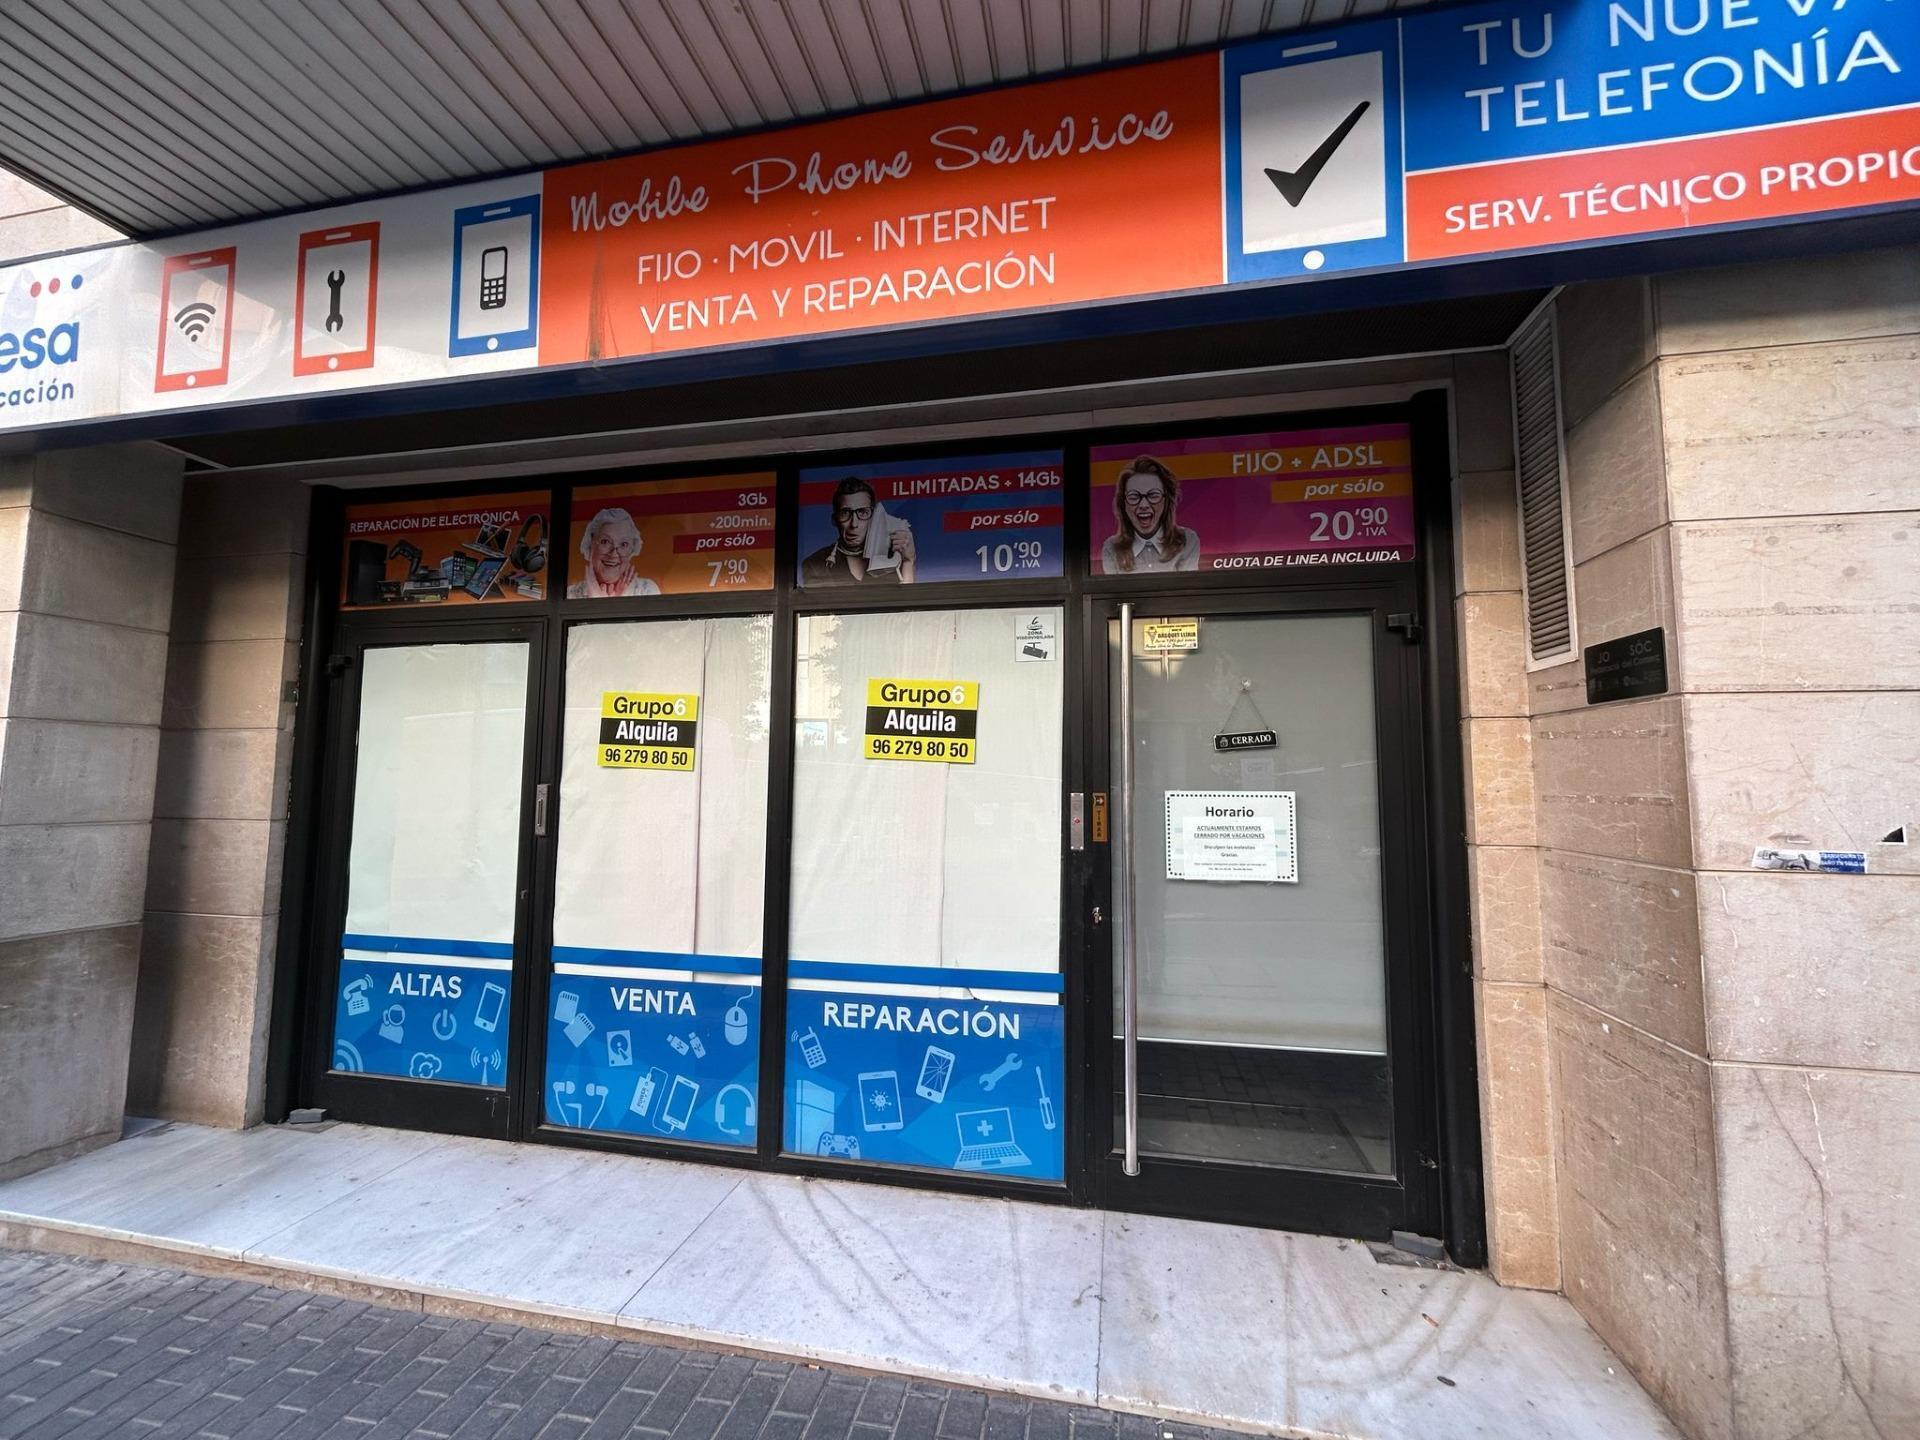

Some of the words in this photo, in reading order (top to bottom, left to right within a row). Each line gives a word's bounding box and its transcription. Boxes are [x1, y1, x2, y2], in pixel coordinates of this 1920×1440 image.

[1462, 13, 1553, 66] TU
[1609, 0, 1895, 47] NUE
[1465, 26, 1902, 132] TELEFONÍA
[732, 152, 912, 203] Phone
[930, 110, 1174, 171] Service
[1444, 196, 1551, 234] SERV.
[1560, 172, 1746, 218] TÉCNICO
[637, 250, 701, 285] FIJO
[729, 229, 844, 273] MOVIL
[873, 196, 1056, 251] INTERNET
[640, 293, 758, 334] VENTA
[771, 287, 792, 318] Y
[803, 250, 1055, 315] REPARACIÓN
[1232, 452, 1282, 474] FIJO
[1311, 445, 1383, 469] ADSL
[892, 474, 999, 496] ILIMITADAS
[1017, 471, 1060, 488] 14Gb
[1304, 483, 1338, 499] por
[1342, 478, 1384, 494] sólo
[737, 493, 768, 506] 3Gb
[421, 516, 437, 528] DE
[439, 510, 520, 526] ELECTRÓNICA
[970, 514, 1000, 529] por
[1003, 509, 1040, 525] sólo
[696, 537, 721, 551] por
[724, 533, 756, 547] sólo
[1213, 556, 1261, 569] CUOTA
[1263, 555, 1284, 567] DE
[1287, 553, 1329, 566] LINEA
[1331, 550, 1401, 563] INCLUIDA
[613, 696, 687, 718] Grupo6
[881, 683, 965, 707] Grupo6
[615, 720, 678, 744] Alquila
[884, 708, 956, 734] Alquila
[873, 739, 890, 754] 96
[895, 740, 922, 755] 279
[926, 741, 945, 757] 80
[950, 742, 968, 757] 50
[1231, 734, 1272, 745] CERRADO
[605, 748, 621, 762] 96
[624, 749, 648, 763] 279
[652, 750, 668, 764] 80
[671, 751, 688, 765] 50
[1205, 806, 1254, 818] Horario
[388, 972, 463, 999] ALTAS
[610, 987, 697, 1016] VENTA
[823, 1001, 1020, 1040] REPARACIÓN
